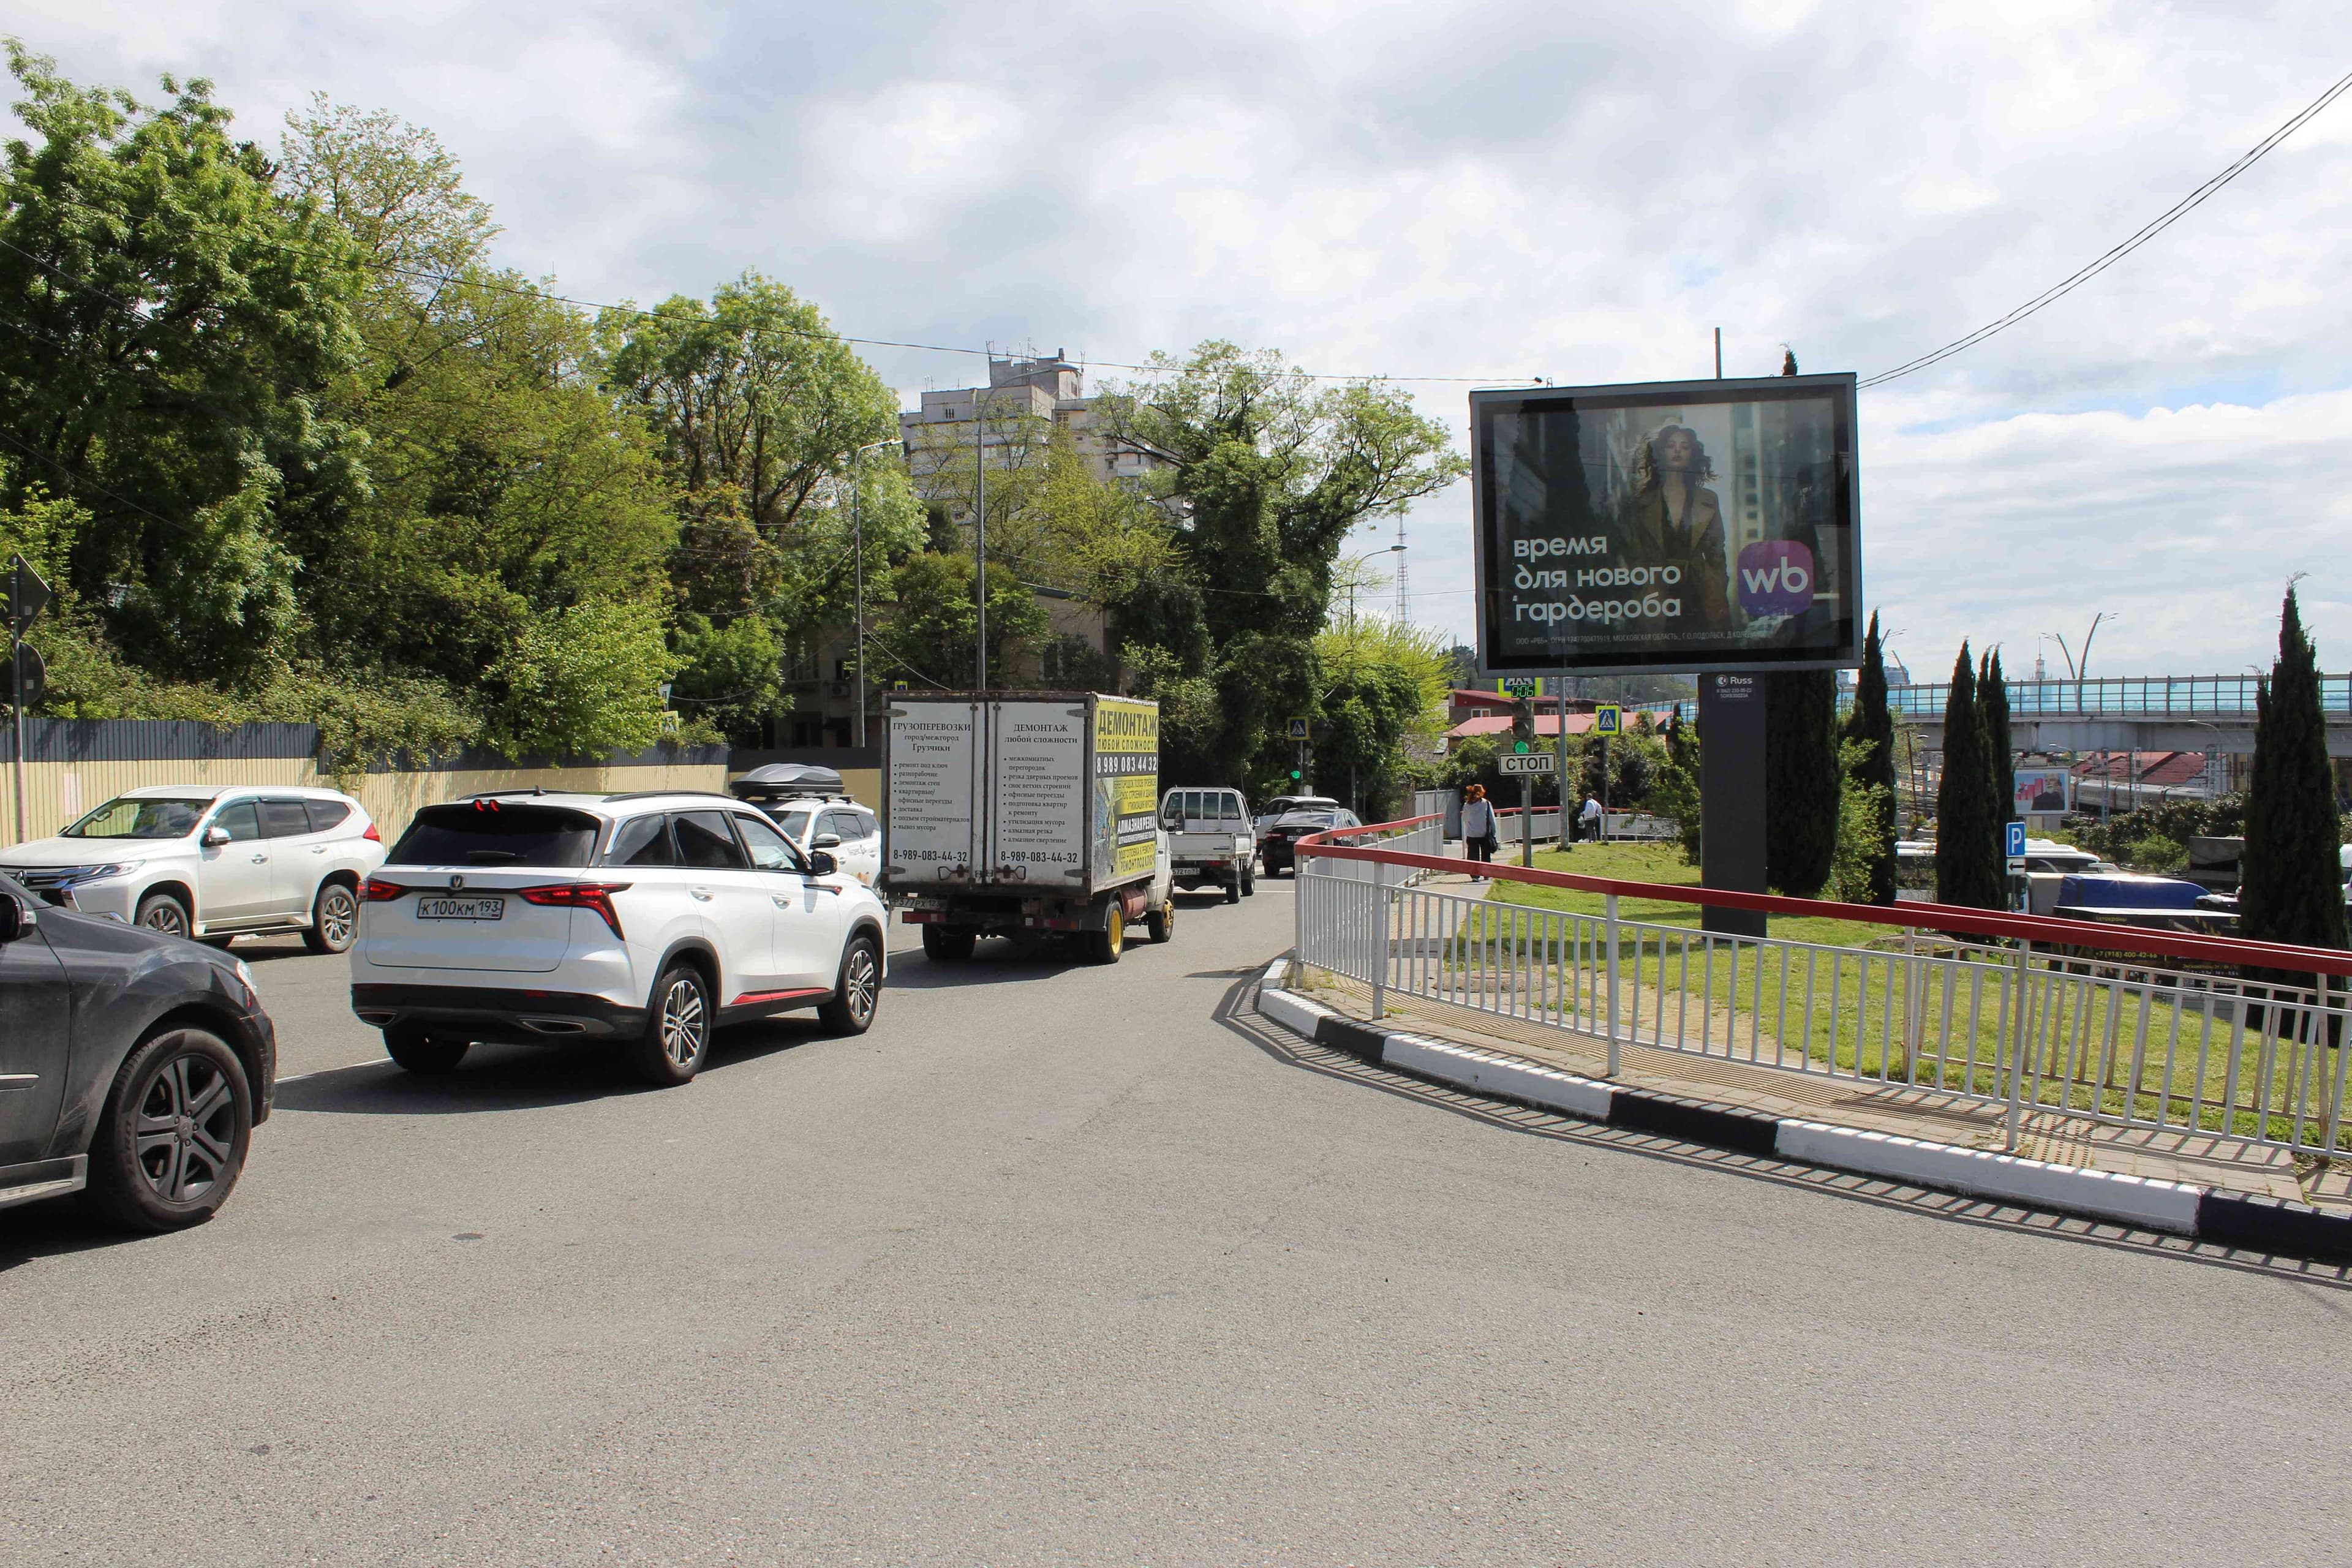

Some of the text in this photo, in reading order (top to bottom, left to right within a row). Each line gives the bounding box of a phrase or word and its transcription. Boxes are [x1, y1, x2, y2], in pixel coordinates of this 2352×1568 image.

[1513, 537, 1607, 562] время
[1515, 564, 1681, 589] для нового
[1742, 556, 1809, 594] wb
[1515, 592, 1681, 626] гардероба
[893, 723, 971, 731] ГРУЗОПЕРЕВОЗКИ
[1098, 710, 1158, 737] ДЕМОНТАЖ
[905, 734, 959, 743] город/межгород
[1097, 737, 1157, 750] ЛЮБОЙ СЛОЖНОСТИ
[913, 744, 950, 753] Грузчики
[1104, 756, 1118, 772] 989
[1121, 756, 1136, 772] 083
[1138, 756, 1147, 771] 44
[1148, 756, 1157, 771] 32
[1507, 757, 1549, 771] СТОП
[894, 850, 967, 862] 8-989-083-44-32
[1001, 851, 1077, 863] 8-989-083-44-32
[478, 901, 499, 912] 193
